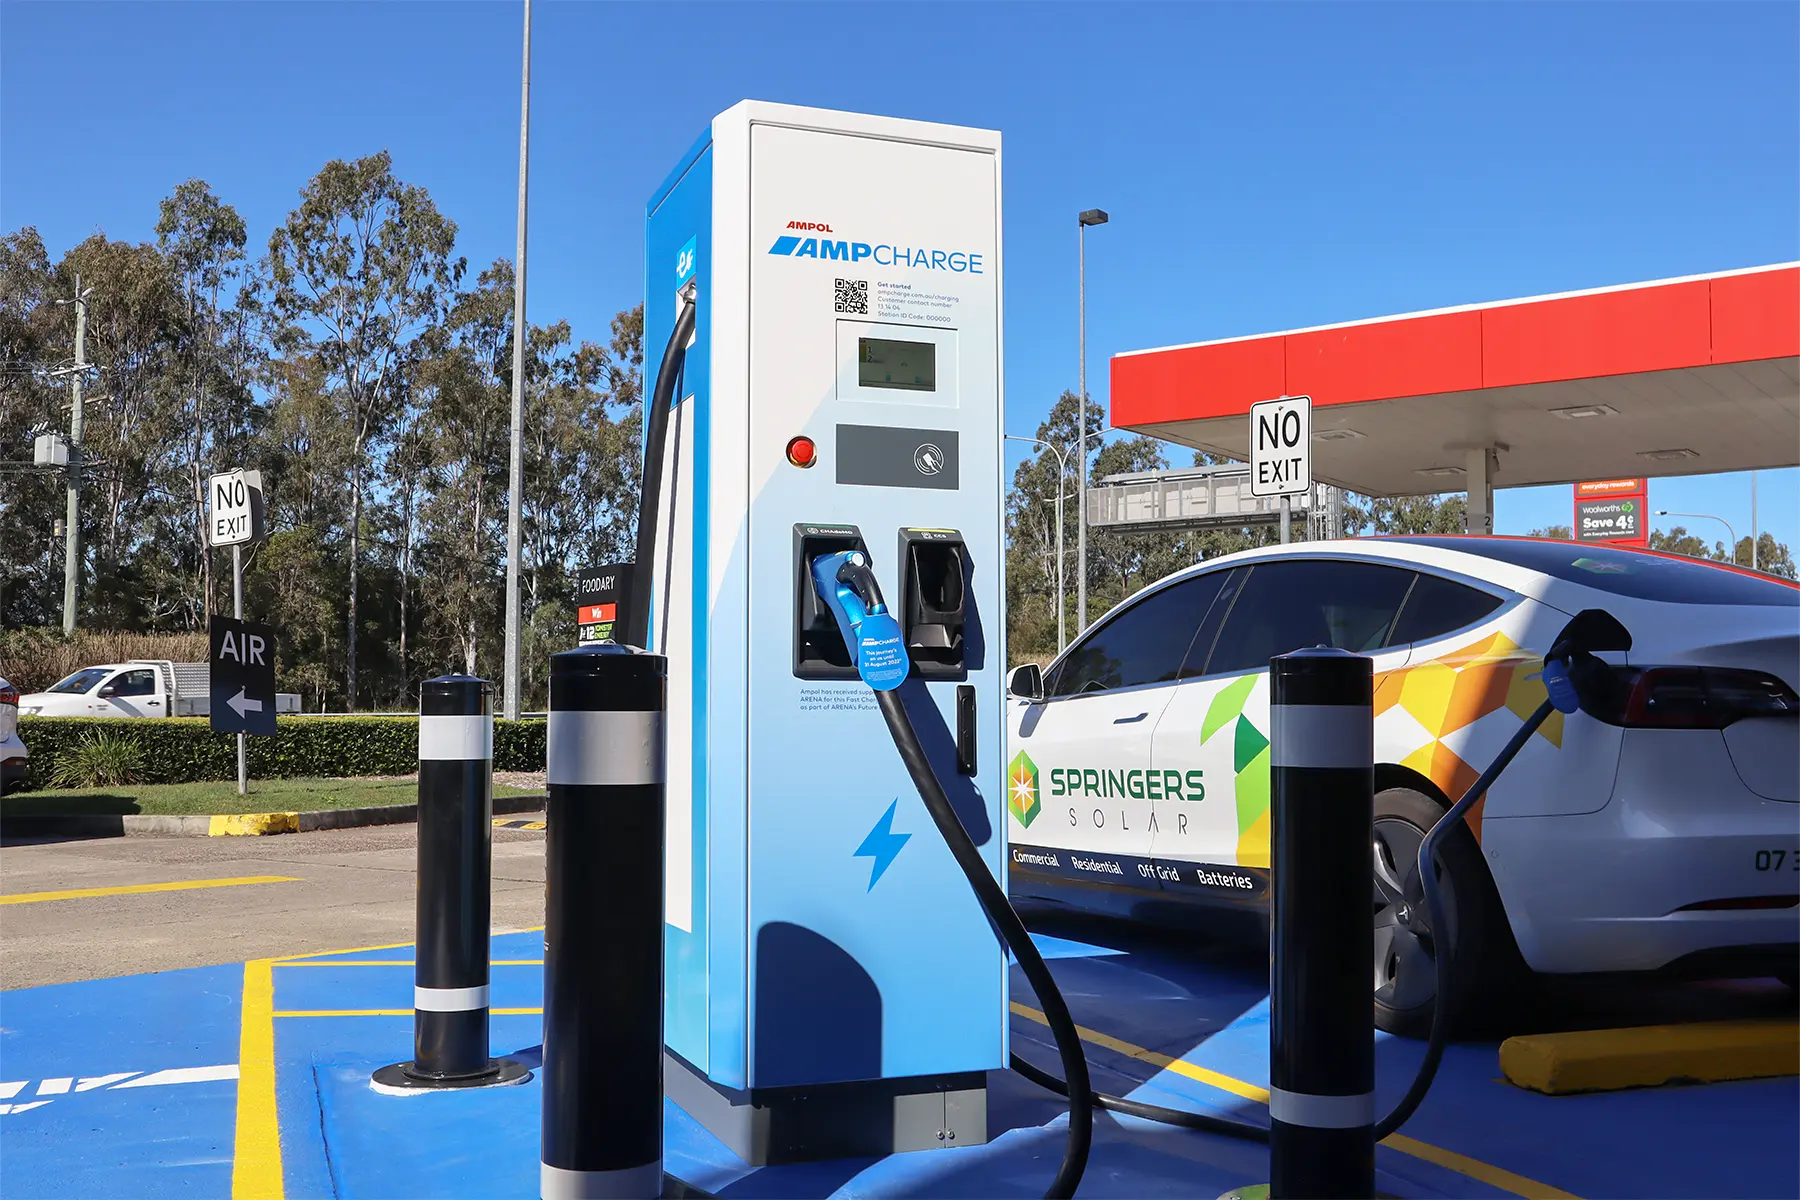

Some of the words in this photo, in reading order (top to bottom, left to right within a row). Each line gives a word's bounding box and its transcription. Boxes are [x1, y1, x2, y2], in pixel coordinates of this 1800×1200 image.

[786, 221, 833, 232] AMPOL
[795, 238, 983, 274] AMPCHARGE
[1260, 410, 1300, 450] NO
[1259, 457, 1302, 484] EXIT
[217, 478, 245, 511] NO
[1484, 516, 1491, 526] 2
[1582, 504, 1620, 514] woolworths
[217, 514, 248, 536] EXIT
[1583, 518, 1614, 529] Save
[582, 576, 615, 593] FOODARY
[219, 631, 266, 666] AIR
[1050, 768, 1206, 801] SPRINGERS
[1069, 808, 1188, 835] SOLAR
[1013, 850, 1060, 867] Commercial
[1072, 856, 1123, 875] Residential
[1137, 864, 1156, 879] Off
[1157, 866, 1180, 882] Grid
[1197, 870, 1253, 889] Batteries
[1756, 850, 1786, 871] 07
